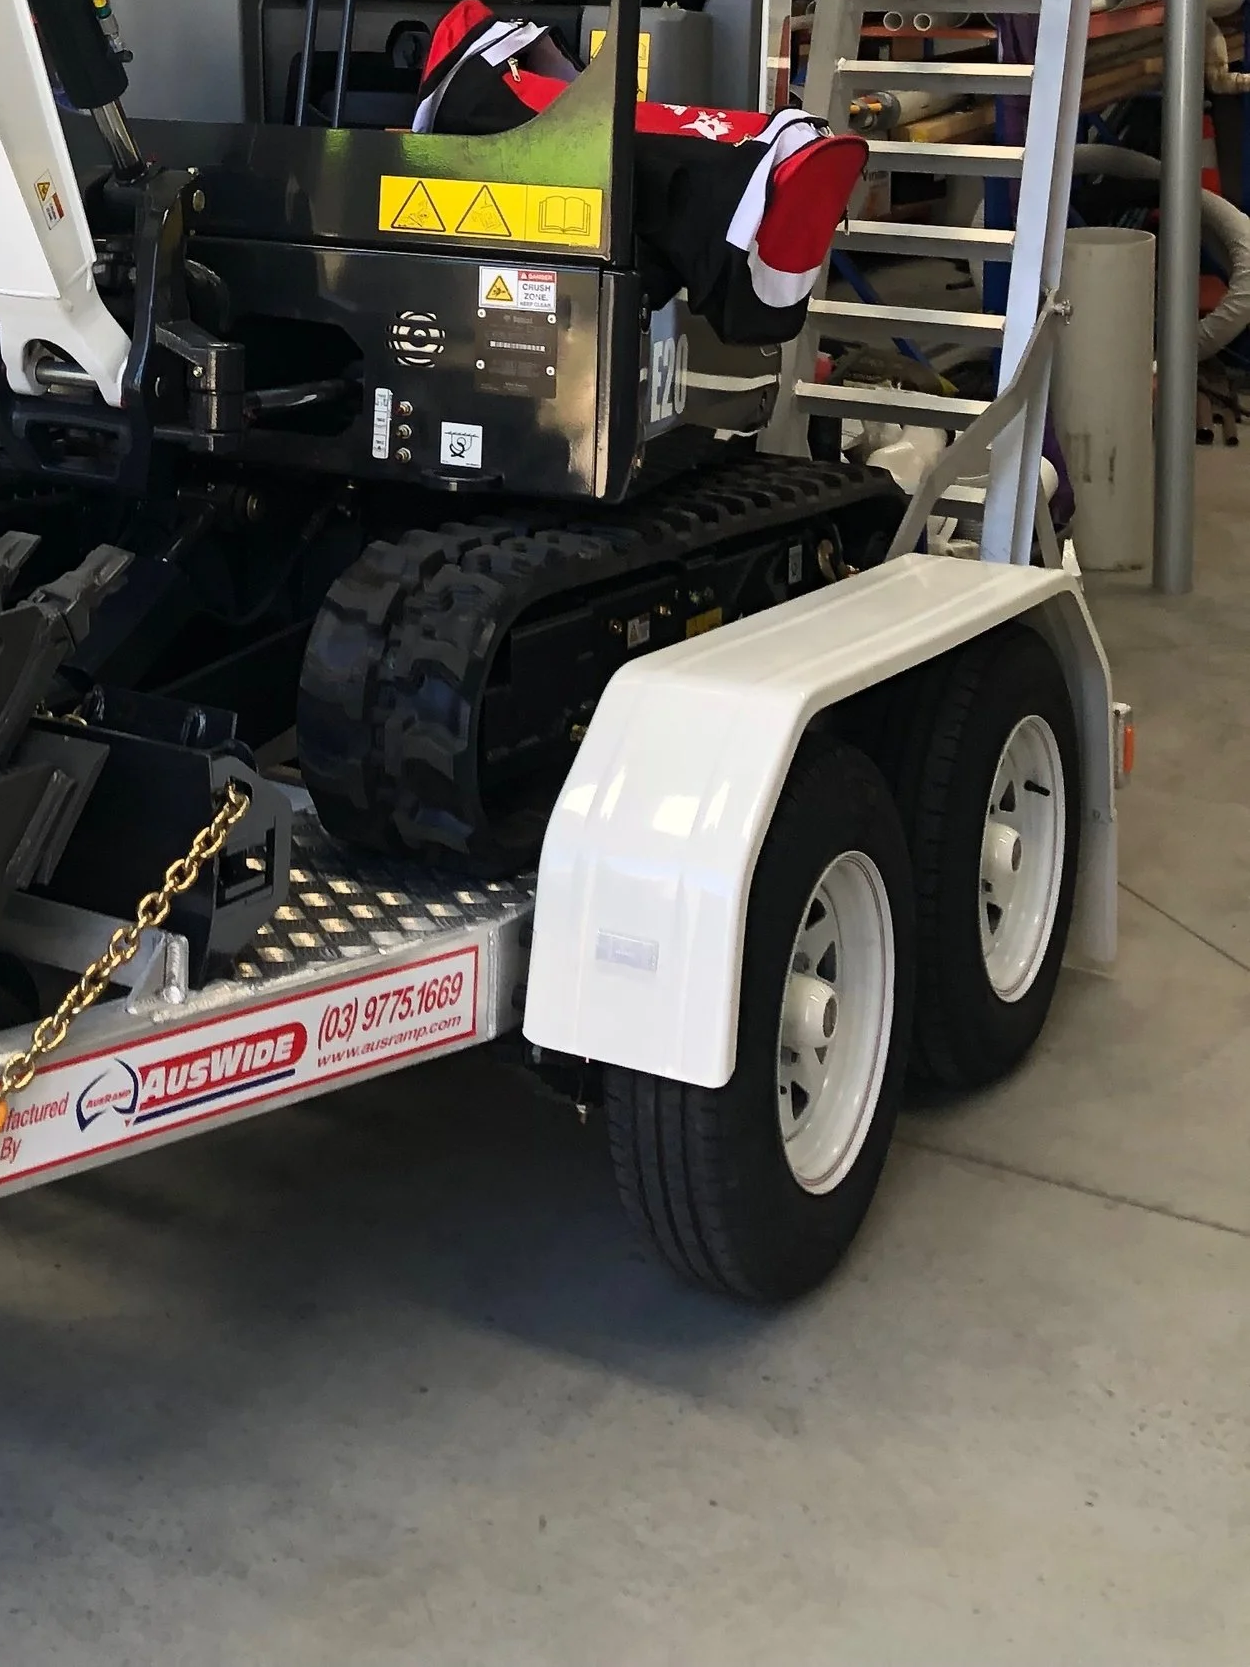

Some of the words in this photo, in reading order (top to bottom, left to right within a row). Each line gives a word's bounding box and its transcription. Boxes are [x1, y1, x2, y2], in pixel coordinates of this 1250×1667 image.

[522, 283, 551, 292] CRUSH
[650, 334, 688, 423] E20
[317, 997, 358, 1051] (03)
[362, 971, 464, 1032] 9775.1669
[316, 1014, 462, 1068] www.ausramp.com
[0, 1137, 22, 1164] By
